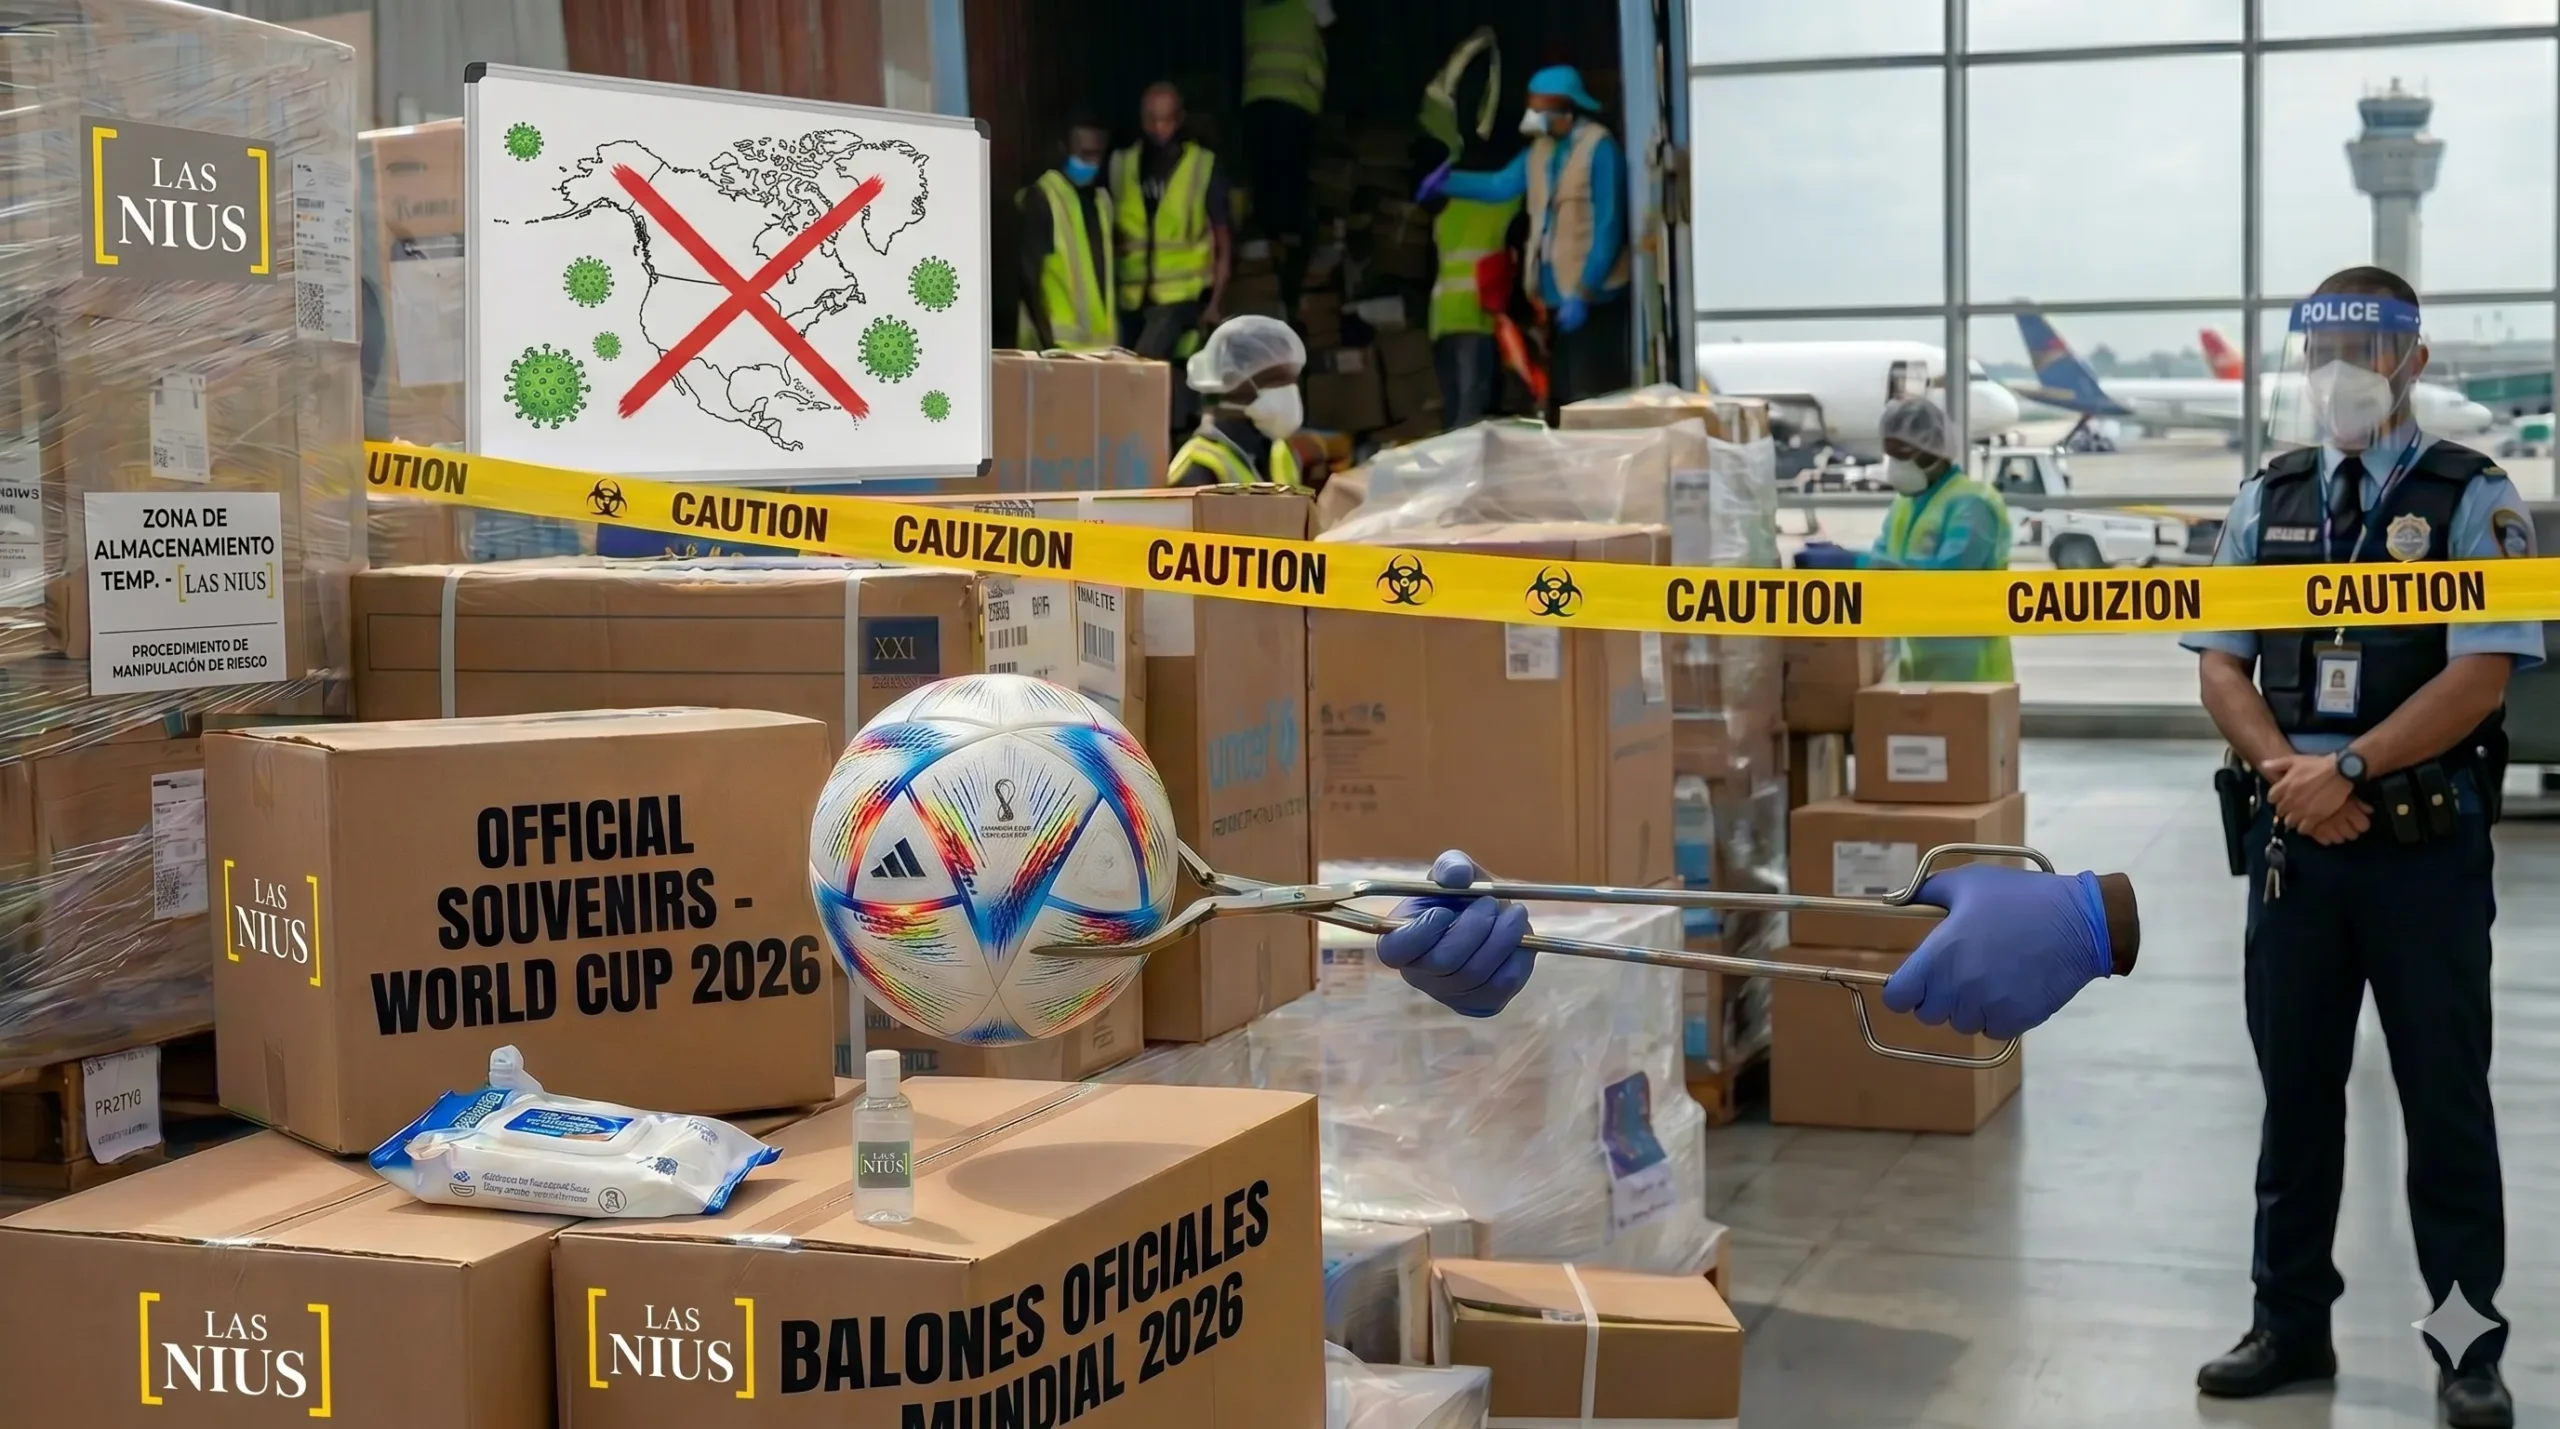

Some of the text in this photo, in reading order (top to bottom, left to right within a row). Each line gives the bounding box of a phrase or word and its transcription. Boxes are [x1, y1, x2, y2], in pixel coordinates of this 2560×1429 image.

[152, 158, 218, 192] LAS
[117, 196, 248, 253] NIUS
[2301, 301, 2380, 323] POLICE
[368, 451, 468, 495] UTION
[143, 508, 228, 528] ZONA DE
[671, 492, 828, 542] CAUTION
[94, 536, 275, 560] ALMACENAMIENTO
[893, 515, 1073, 570] CAUIZION
[101, 570, 160, 591] TEMP.
[1148, 539, 1327, 594] CAUTION
[1667, 578, 1862, 624] CAUTION
[2008, 579, 2201, 623] CAUIZION
[2306, 570, 2486, 617] CAUTION
[112, 655, 268, 679] MANIPULACIÓN DE RIESGO
[132, 638, 249, 658] PROCEDIMIENTO DE
[874, 636, 917, 660] XXI
[477, 795, 694, 869] OFFICIAL
[255, 878, 288, 910] LAS
[437, 867, 717, 950] SOUVENIRS
[236, 905, 308, 964] NIUS
[371, 935, 821, 1036] WORLD CUP 2026
[863, 1159, 905, 1174] NIUS
[781, 1179, 1270, 1394] BALONES OFICIALES
[205, 1310, 268, 1342] LAS
[644, 1304, 701, 1332] LAS
[1138, 1271, 1244, 1385] 2026
[161, 1345, 308, 1399] NIUS
[608, 1334, 735, 1384] NIUS
